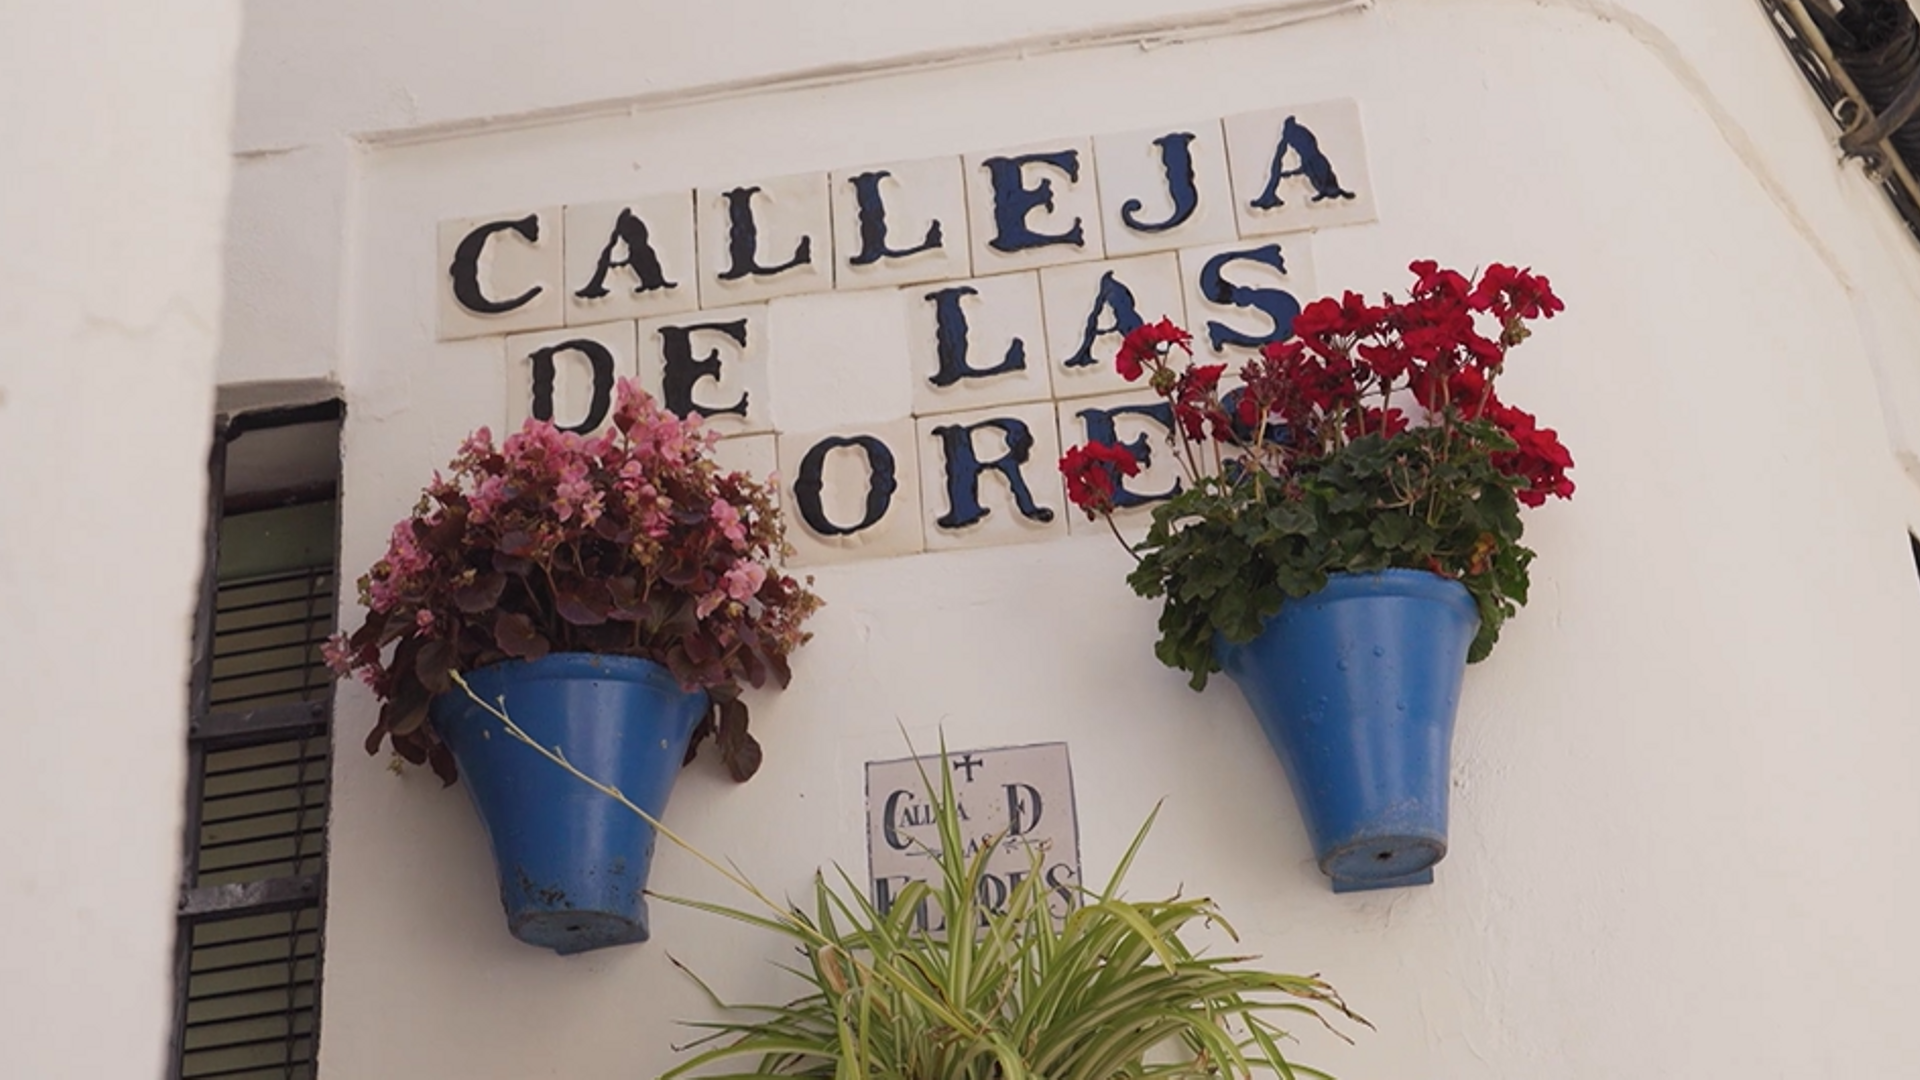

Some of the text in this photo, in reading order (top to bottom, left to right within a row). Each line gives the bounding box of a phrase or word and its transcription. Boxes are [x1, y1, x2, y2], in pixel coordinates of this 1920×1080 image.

[448, 114, 1357, 315] CALLEJA
[528, 243, 1301, 436] DE LAS
[792, 387, 1294, 537] ORE
